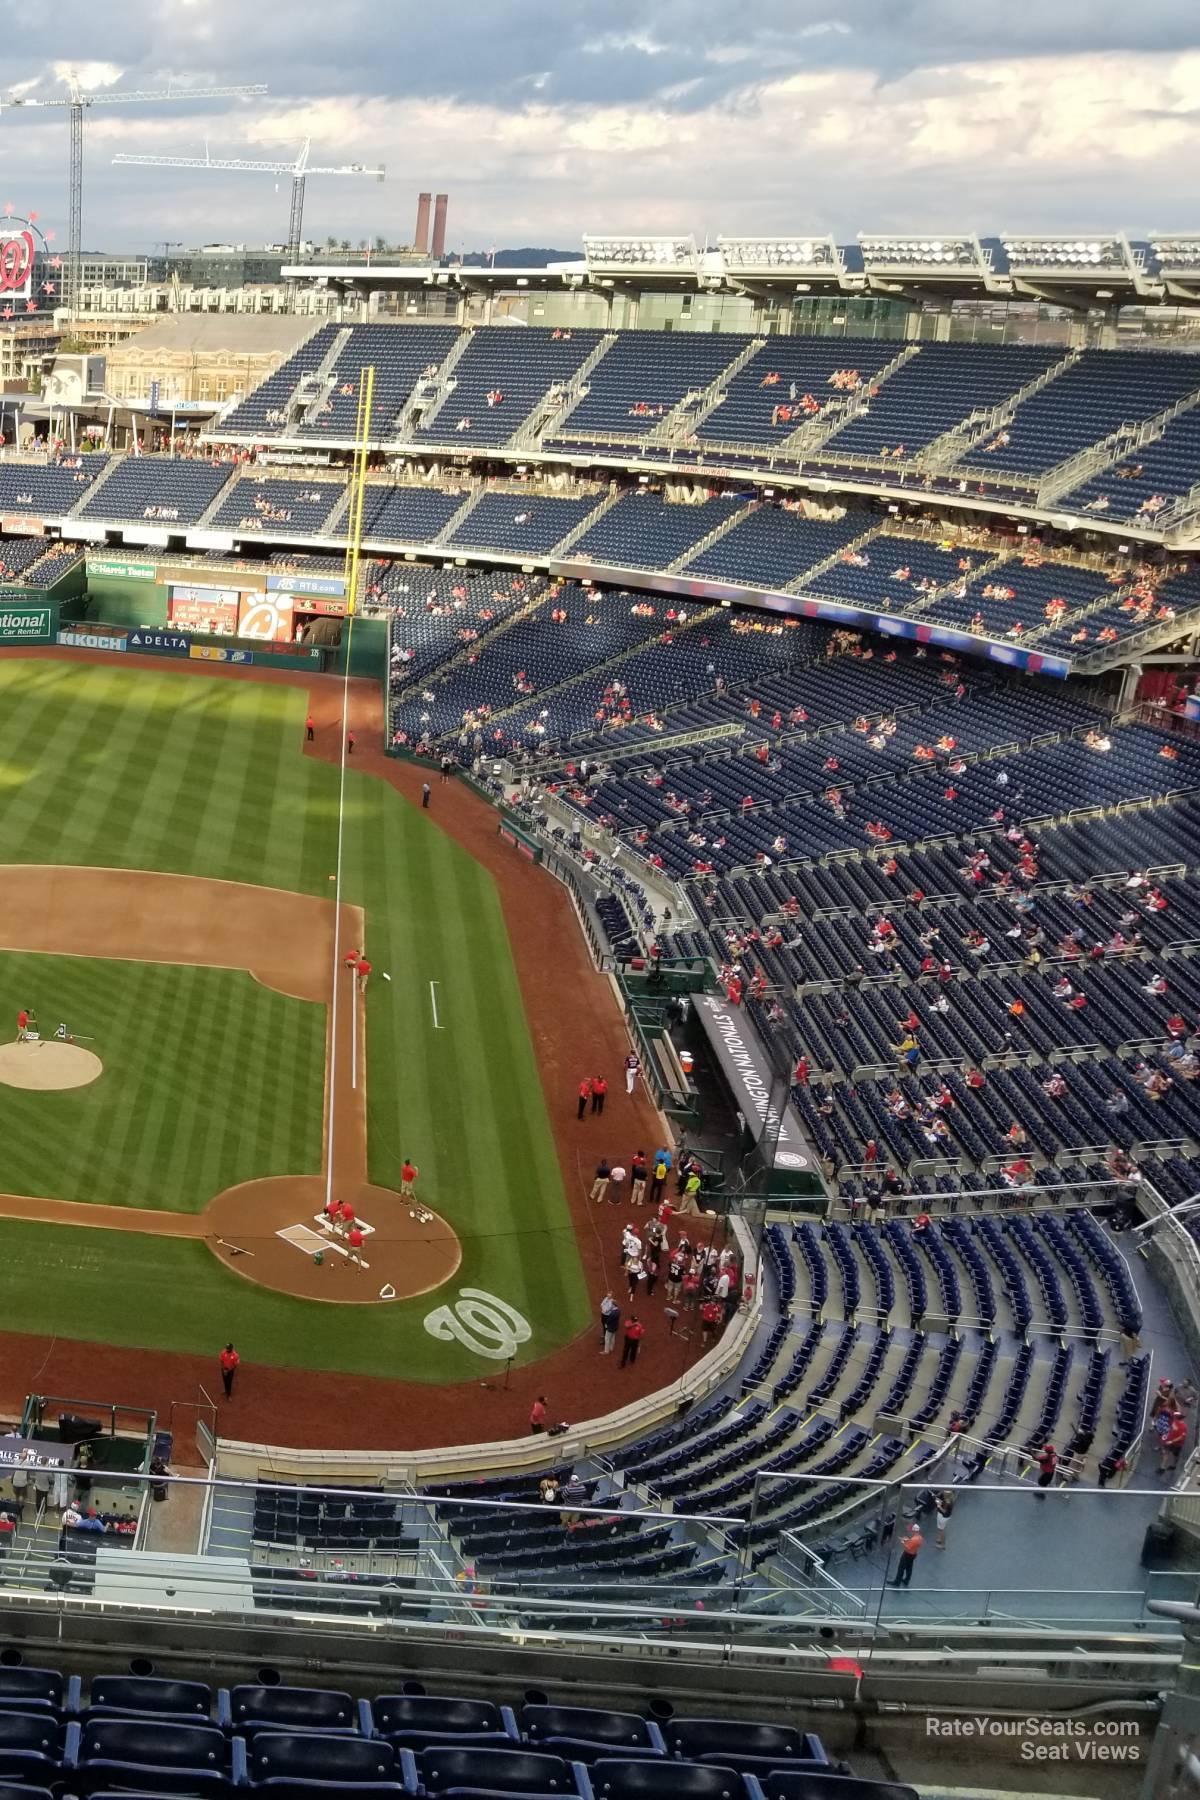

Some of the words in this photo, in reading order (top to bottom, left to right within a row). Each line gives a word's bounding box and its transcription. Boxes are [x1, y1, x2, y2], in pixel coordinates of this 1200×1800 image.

[77, 635, 122, 650] KOCH
[144, 635, 188, 649] DELTA
[712, 1014, 751, 1068] NATIONALS
[741, 1066, 791, 1141] WASHINGTON
